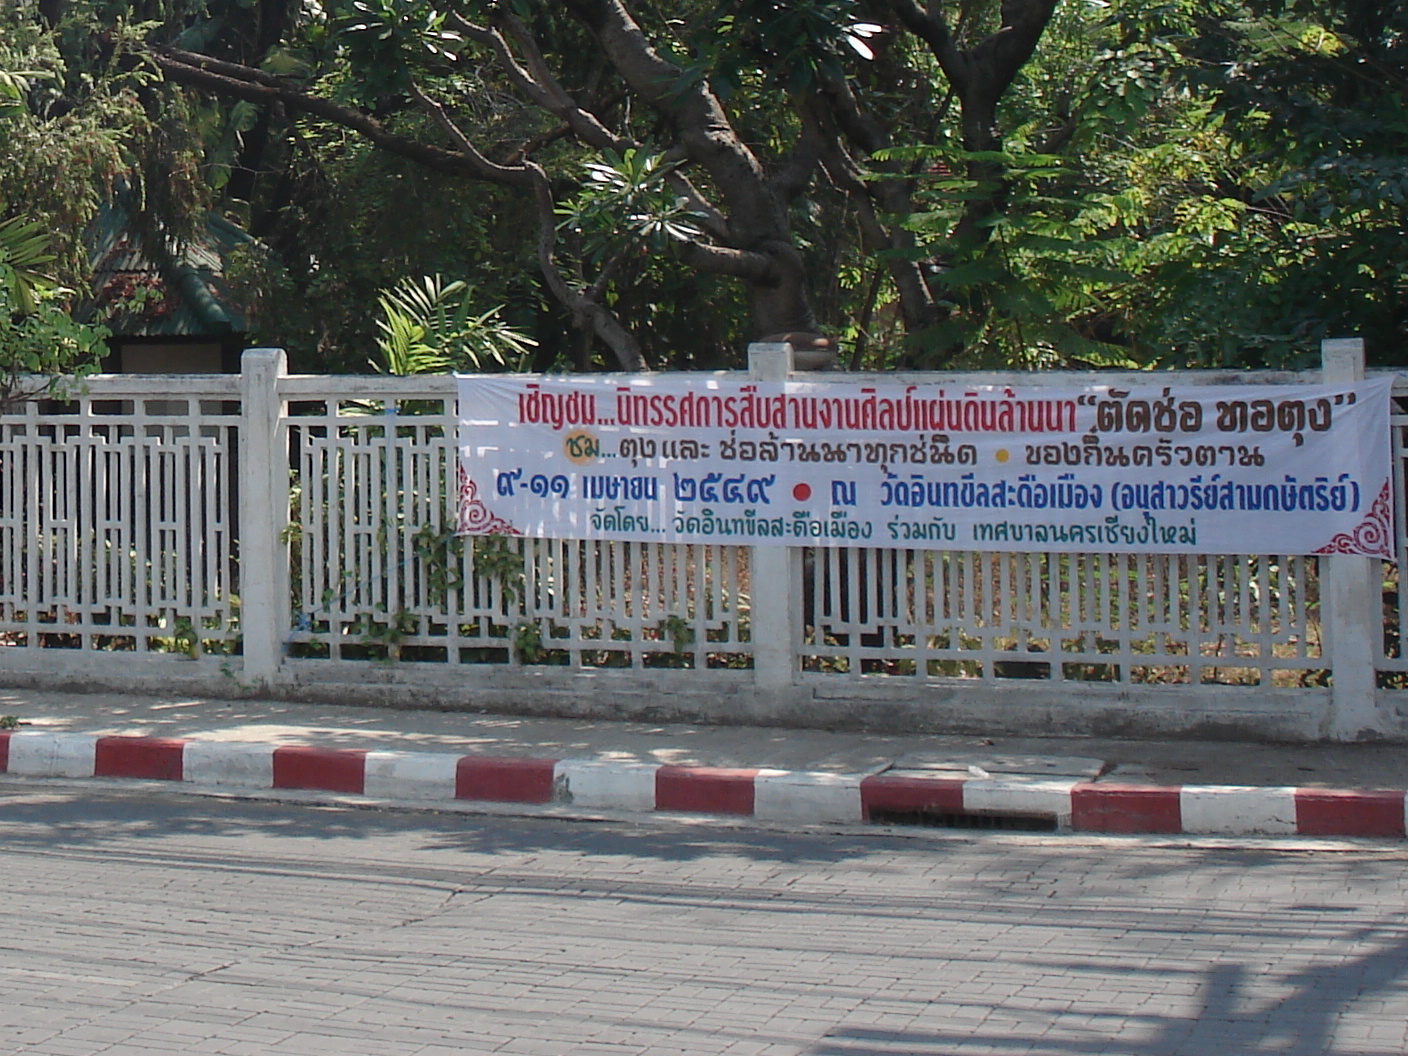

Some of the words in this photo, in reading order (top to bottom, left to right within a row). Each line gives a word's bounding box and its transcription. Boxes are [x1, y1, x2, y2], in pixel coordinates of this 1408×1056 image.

[583, 474, 657, 501] เมษายน
[673, 472, 776, 504] ๒๕๔๙
[831, 479, 857, 506] ณ
[887, 514, 956, 542] ร่วมกับ
[973, 515, 1197, 546] เทศบาลนครเชียงใหม่
